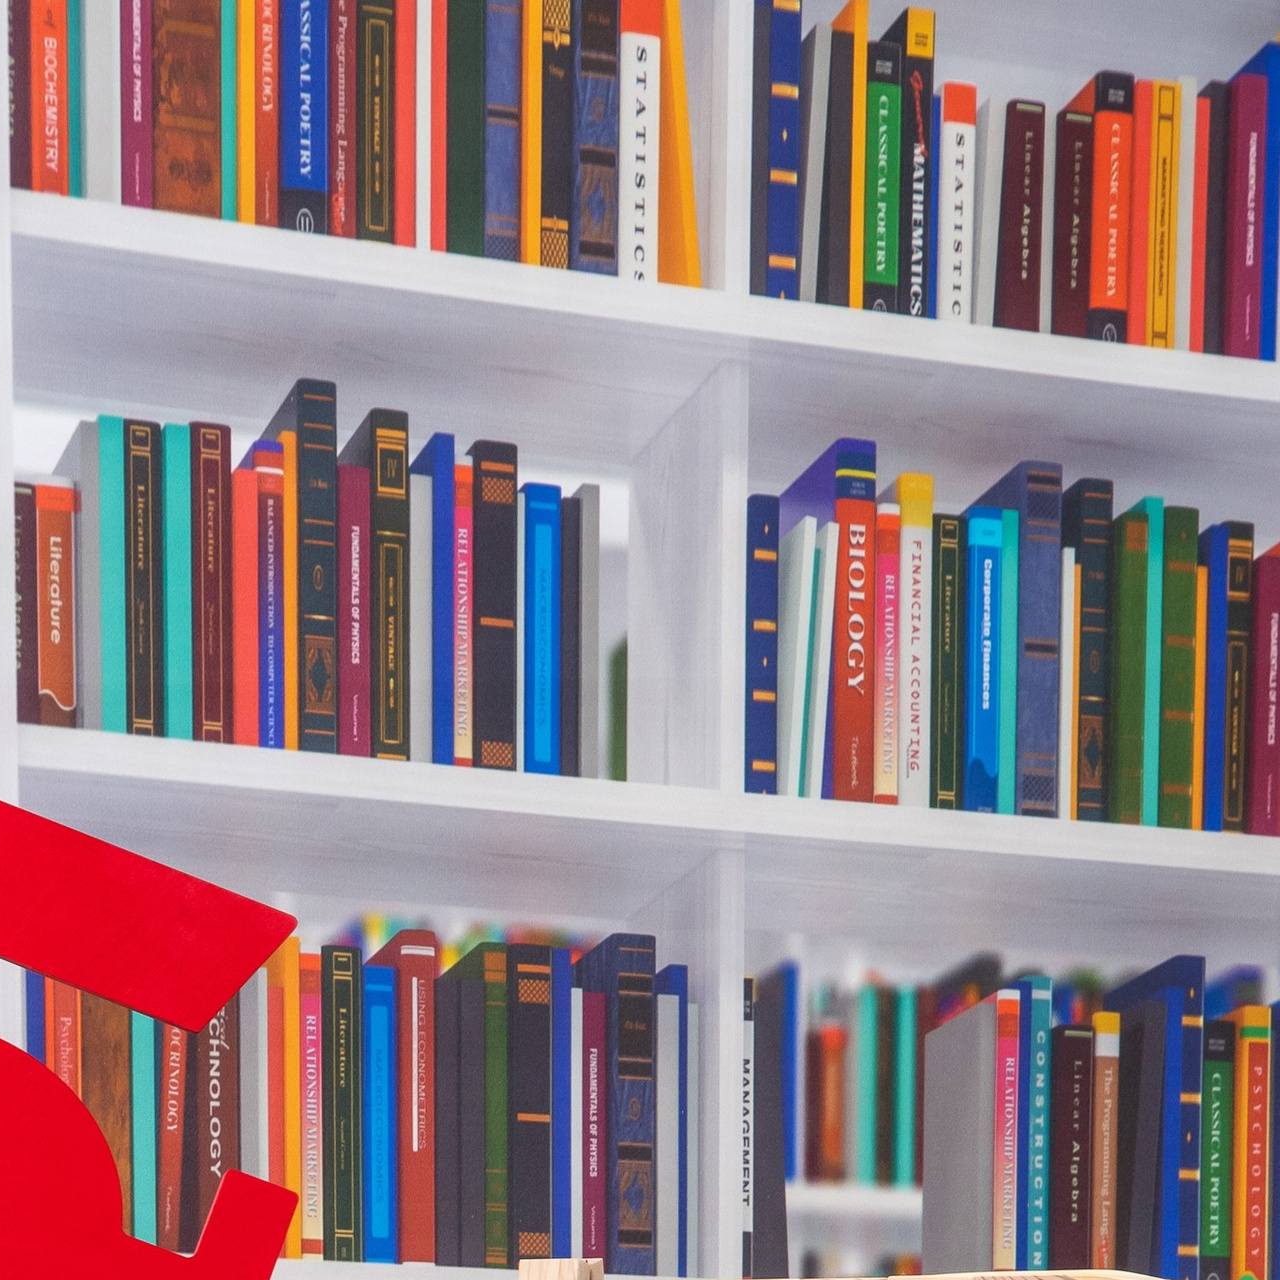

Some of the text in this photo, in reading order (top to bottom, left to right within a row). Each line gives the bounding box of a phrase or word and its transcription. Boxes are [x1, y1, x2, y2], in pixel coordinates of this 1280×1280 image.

[44, 37, 58, 172] BIOCHEMISTRY
[299, 92, 312, 180] POETRY
[336, 15, 348, 135] Programming
[634, 44, 648, 282] STATISTICS
[875, 95, 889, 275] CLASSICAL POETRY
[909, 142, 926, 316] MATHEMATICS
[951, 132, 965, 316] STATISTIC
[1021, 130, 1033, 281] Linear Algebra
[1070, 141, 1083, 288] Linear Algebra
[1106, 122, 1120, 297] CLASSICAL POETRY
[49, 536, 63, 645] Literature
[137, 485, 146, 571] Literature
[207, 488, 216, 573] Literature
[351, 526, 360, 664] FUNDAMENTALS OF PHYSICS
[846, 523, 866, 696] BIOLOGY
[456, 528, 468, 736] RELATIONSHIP MARKETING
[882, 574, 895, 775] RELATIONSHIP MARKETING
[909, 540, 922, 771] FINANCIAL ACCOUNTING
[945, 574, 953, 654] Literature
[982, 558, 993, 710] Corporate Finances
[209, 1013, 222, 1178] CHNOLOGY
[306, 1015, 318, 1220] RELATIONSHIP MARKETING
[338, 1007, 347, 1089] Literature
[418, 979, 427, 1150] USING ECONOMETRICS
[589, 1047, 598, 1178] FUNDAMENTALS OF PHYSICS
[742, 1058, 751, 1207] MANAGEMENT
[1002, 1057, 1015, 1250] RELATIONSHIP MARKETING
[1033, 1030, 1046, 1266] CONSTRUCTION
[1070, 1060, 1082, 1223] Linear Algebra
[1101, 1066, 1113, 1197] The Programming
[1207, 1072, 1222, 1246] CLASSICAL POETRY
[1250, 1065, 1264, 1257] PSYCHOLOGY
